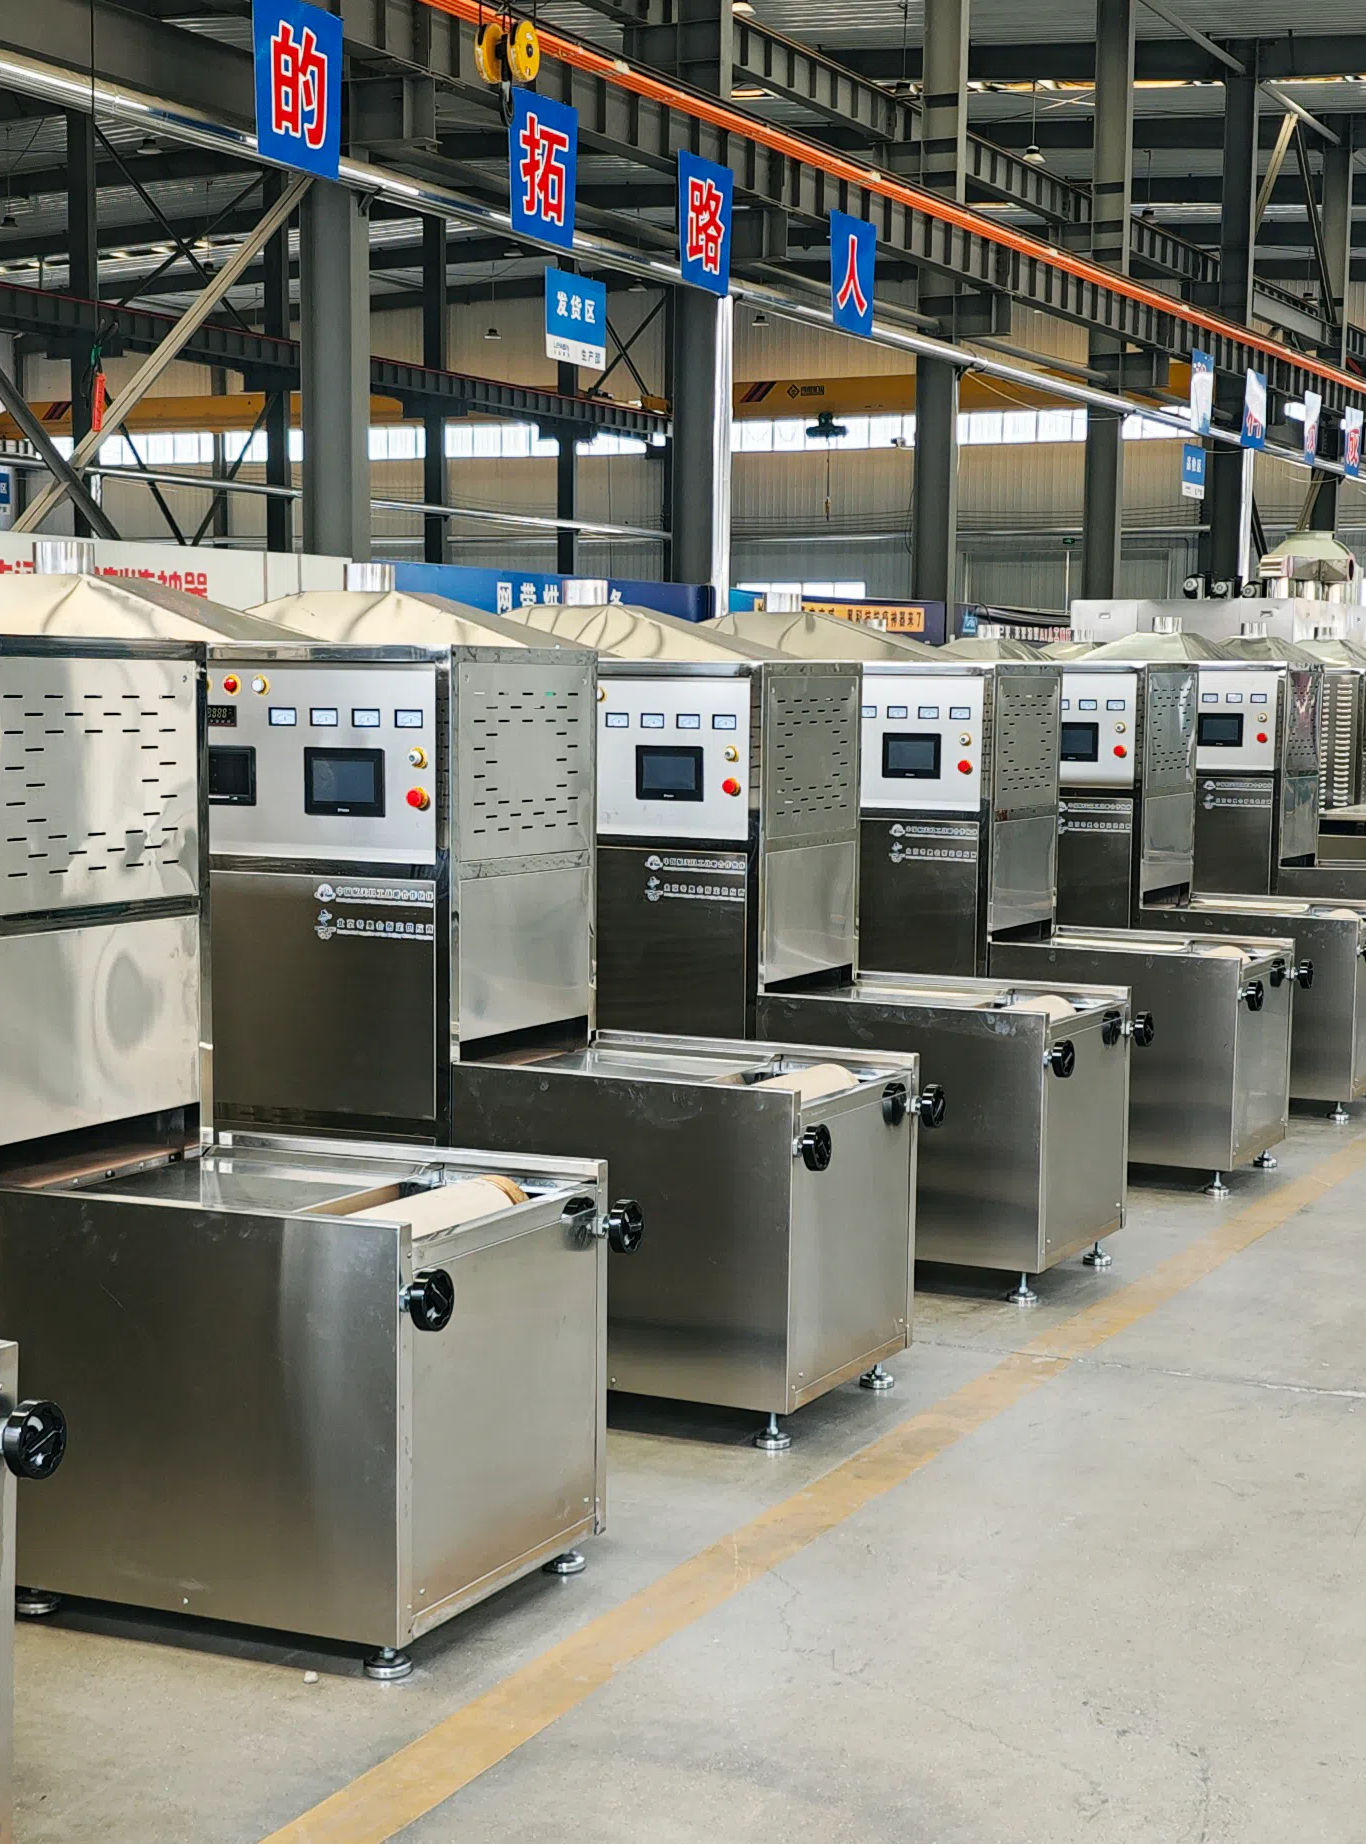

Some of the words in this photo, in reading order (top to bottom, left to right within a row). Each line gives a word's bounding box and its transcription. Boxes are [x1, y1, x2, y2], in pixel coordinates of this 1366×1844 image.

[270, 19, 329, 149] 的
[519, 112, 568, 226] 拓
[686, 176, 725, 275] 路
[836, 234, 868, 317] 人
